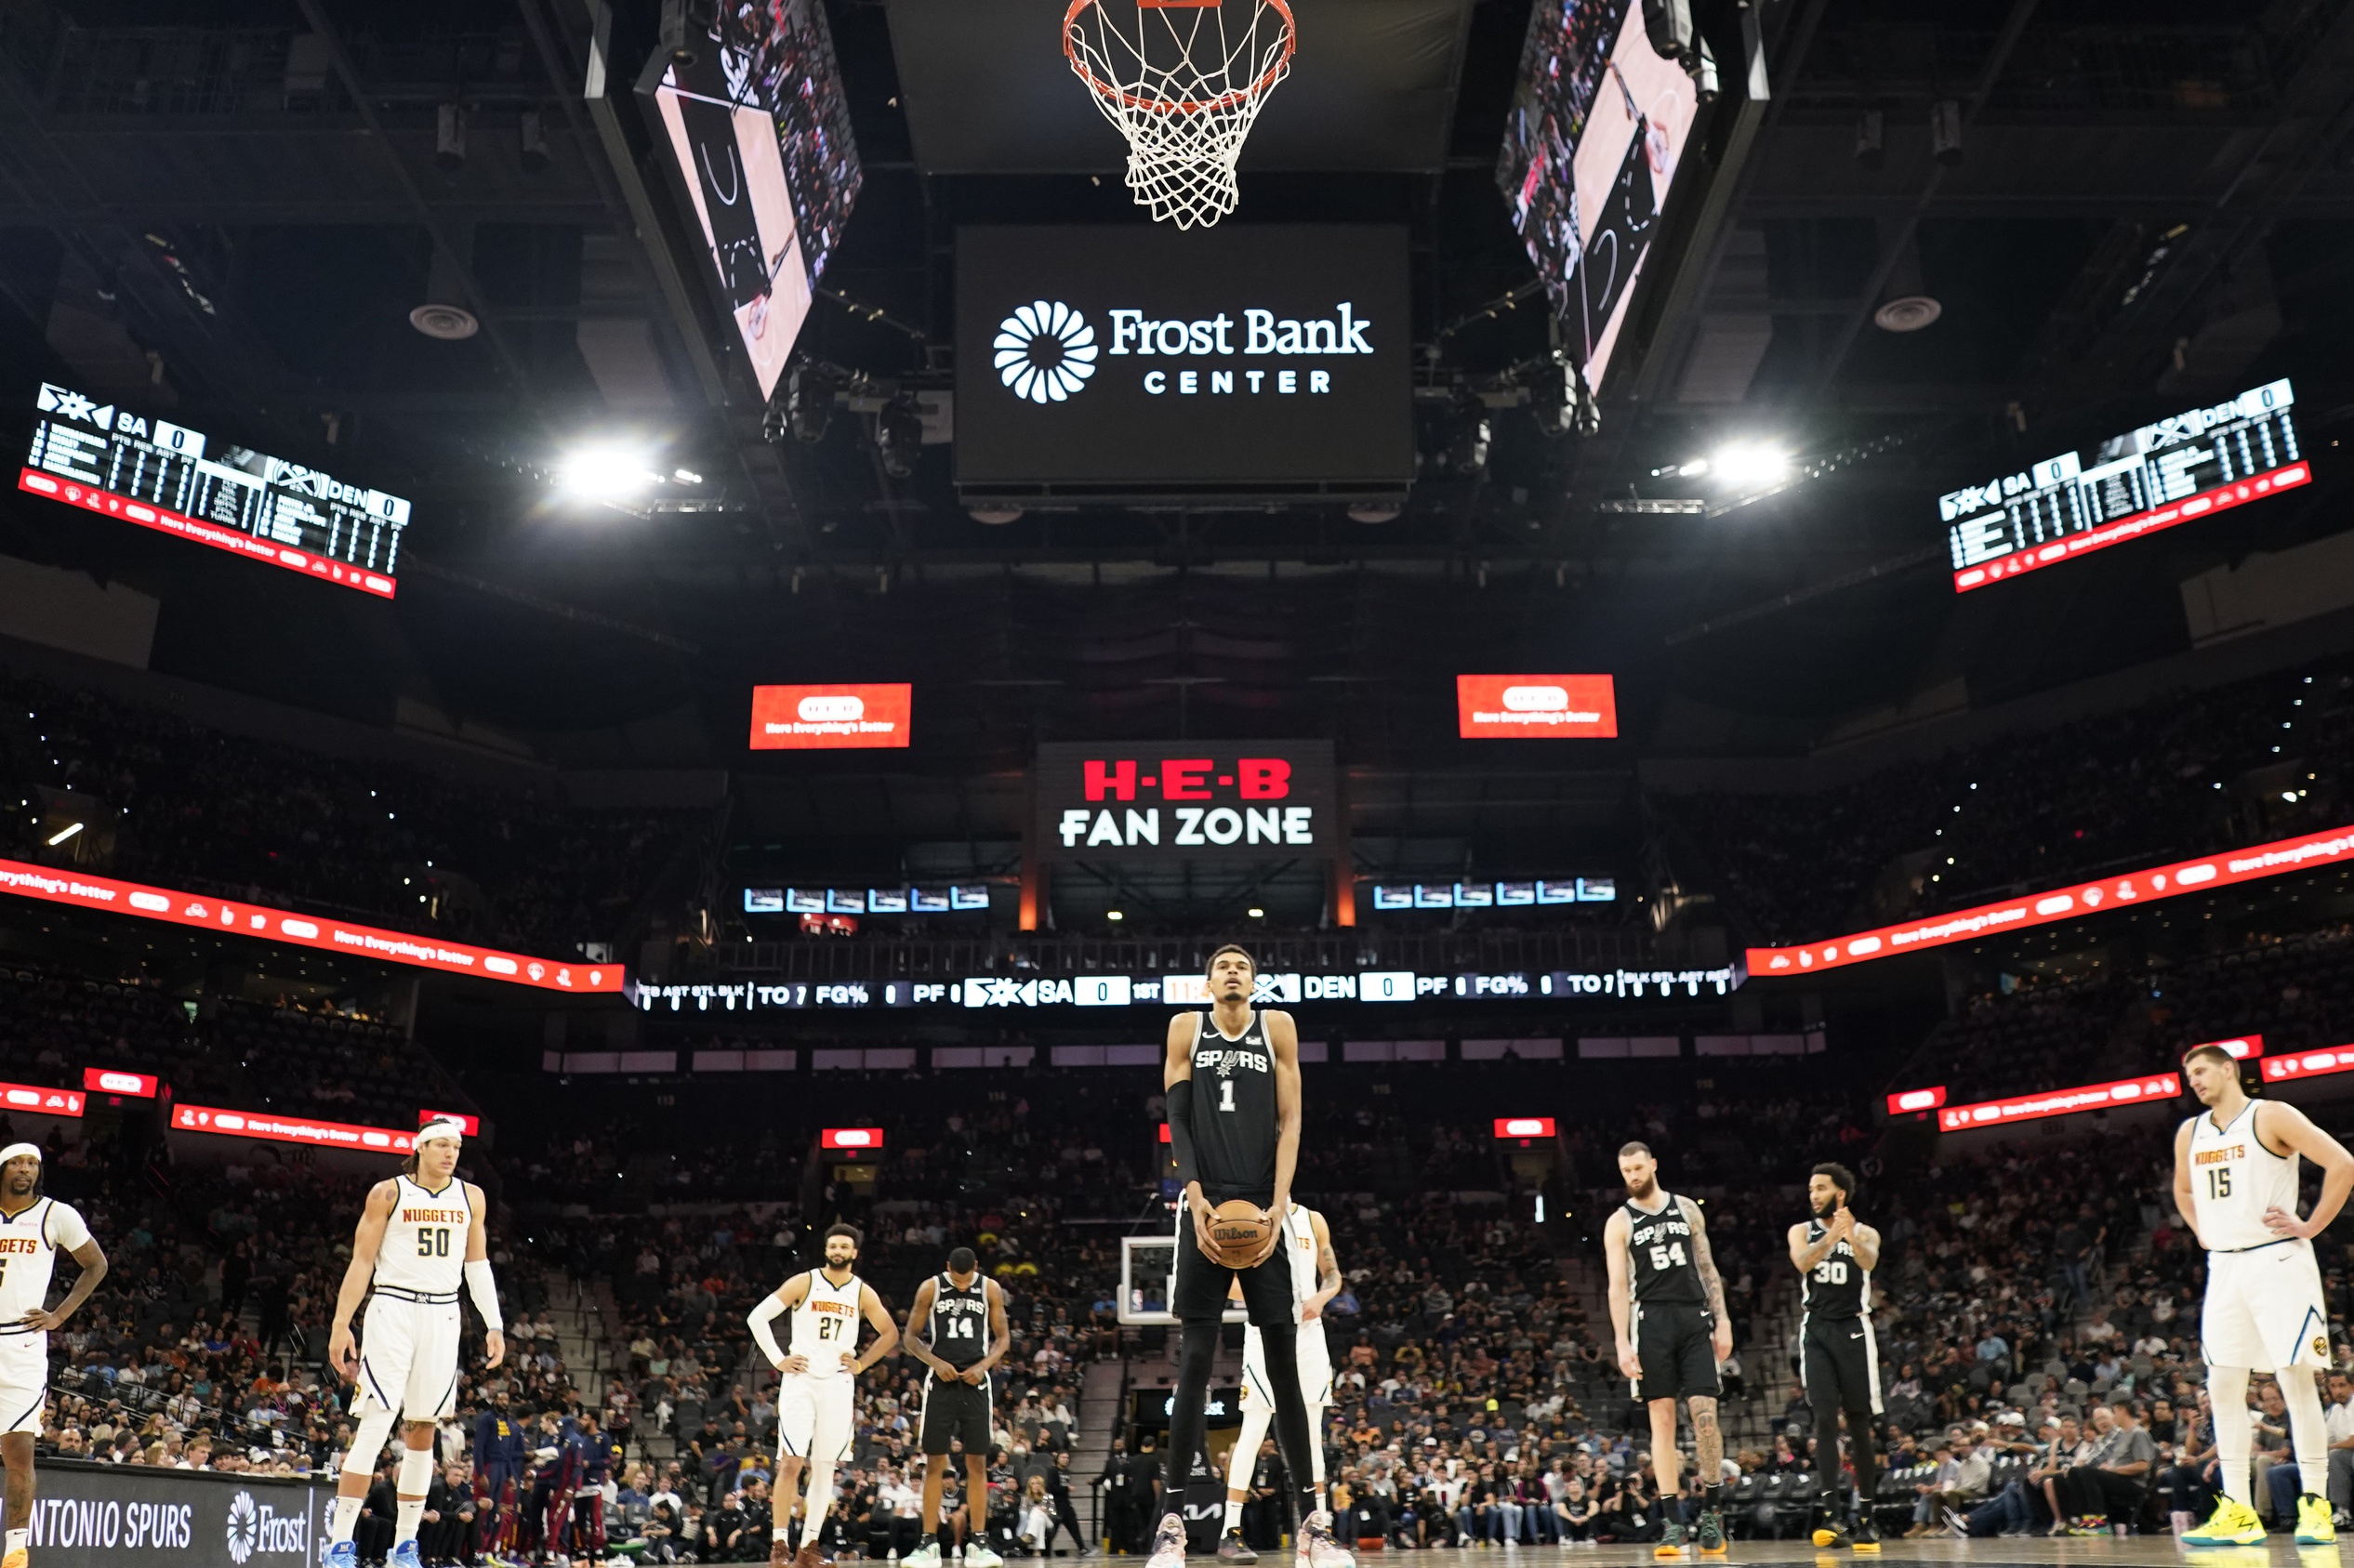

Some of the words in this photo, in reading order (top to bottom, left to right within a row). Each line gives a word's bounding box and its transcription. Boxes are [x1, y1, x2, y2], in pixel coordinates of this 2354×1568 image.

[1108, 309, 1235, 355] Frost
[1243, 301, 1374, 355] Bank
[1144, 370, 1330, 394] CENTER
[2201, 398, 2245, 428] DEN
[117, 412, 148, 439] SA
[171, 429, 185, 449] 0
[2002, 472, 2032, 495] SA
[328, 480, 368, 508] DEN
[383, 498, 395, 516] 0
[1084, 758, 1291, 801] H-E-B
[1059, 808, 1159, 847] FAN
[1174, 806, 1314, 846] ZONE
[70, 882, 116, 901] Better
[334, 929, 364, 946] Here
[364, 935, 436, 960] Everything's
[662, 985, 690, 997] AST
[691, 984, 717, 997] STL
[757, 986, 790, 1005] TO
[815, 985, 868, 1005] FG%
[913, 983, 946, 1003] PF
[1038, 979, 1074, 1004] SA
[1098, 982, 1107, 1001] 0
[1132, 983, 1161, 1000] 1ST
[1171, 982, 1210, 1000] 11:4
[1304, 976, 1356, 999] DEN
[1383, 978, 1393, 996] 0
[1417, 978, 1448, 995] PF
[1475, 975, 1528, 995] FG%
[1567, 974, 1601, 993] TO
[1196, 1050, 1268, 1075] SPURS
[1219, 1080, 1236, 1112] 1
[2195, 1144, 2244, 1166] NUGGETS
[2208, 1167, 2231, 1200] 15
[403, 1208, 464, 1224] NUGGETS
[417, 1227, 450, 1257] 50
[1213, 1227, 1258, 1241] Wilson
[1633, 1221, 1690, 1245] SPURS
[1648, 1242, 1688, 1271] 54
[1814, 1260, 1847, 1285] 30
[812, 1300, 855, 1318] NUGGETS
[936, 1298, 985, 1316] SPURS
[820, 1316, 843, 1340] 27
[947, 1317, 974, 1338] 14
[27, 1498, 120, 1548] NTONIO
[125, 1501, 192, 1548] SPURS
[257, 1504, 308, 1554] Frost
